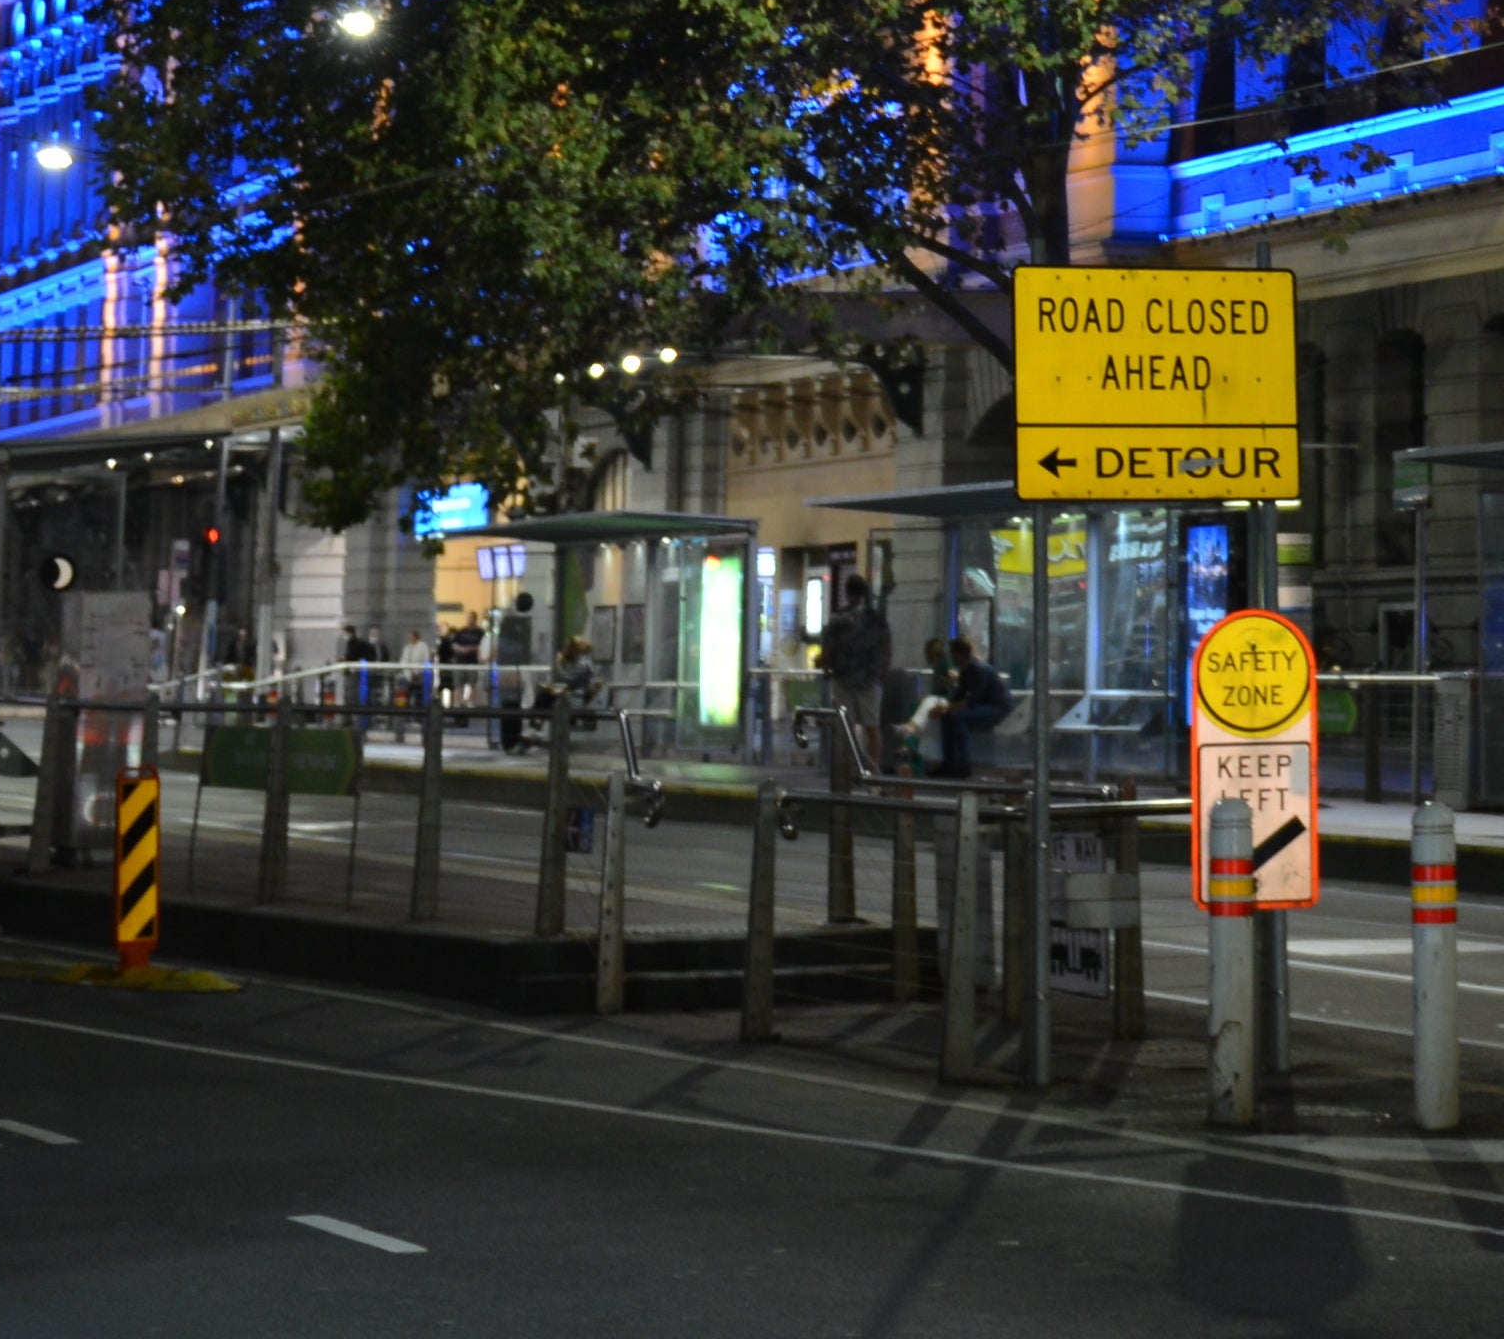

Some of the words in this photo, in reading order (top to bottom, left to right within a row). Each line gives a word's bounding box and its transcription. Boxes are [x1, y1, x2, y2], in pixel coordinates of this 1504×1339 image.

[1038, 297, 1125, 333] ROAD
[1146, 298, 1269, 335] CLOSED
[1101, 355, 1211, 390] AHEAD
[1096, 447, 1281, 479] DETOUR
[1207, 650, 1296, 673] SAFETY
[1222, 685, 1283, 707] ZONE
[1217, 755, 1292, 779] KEEP
